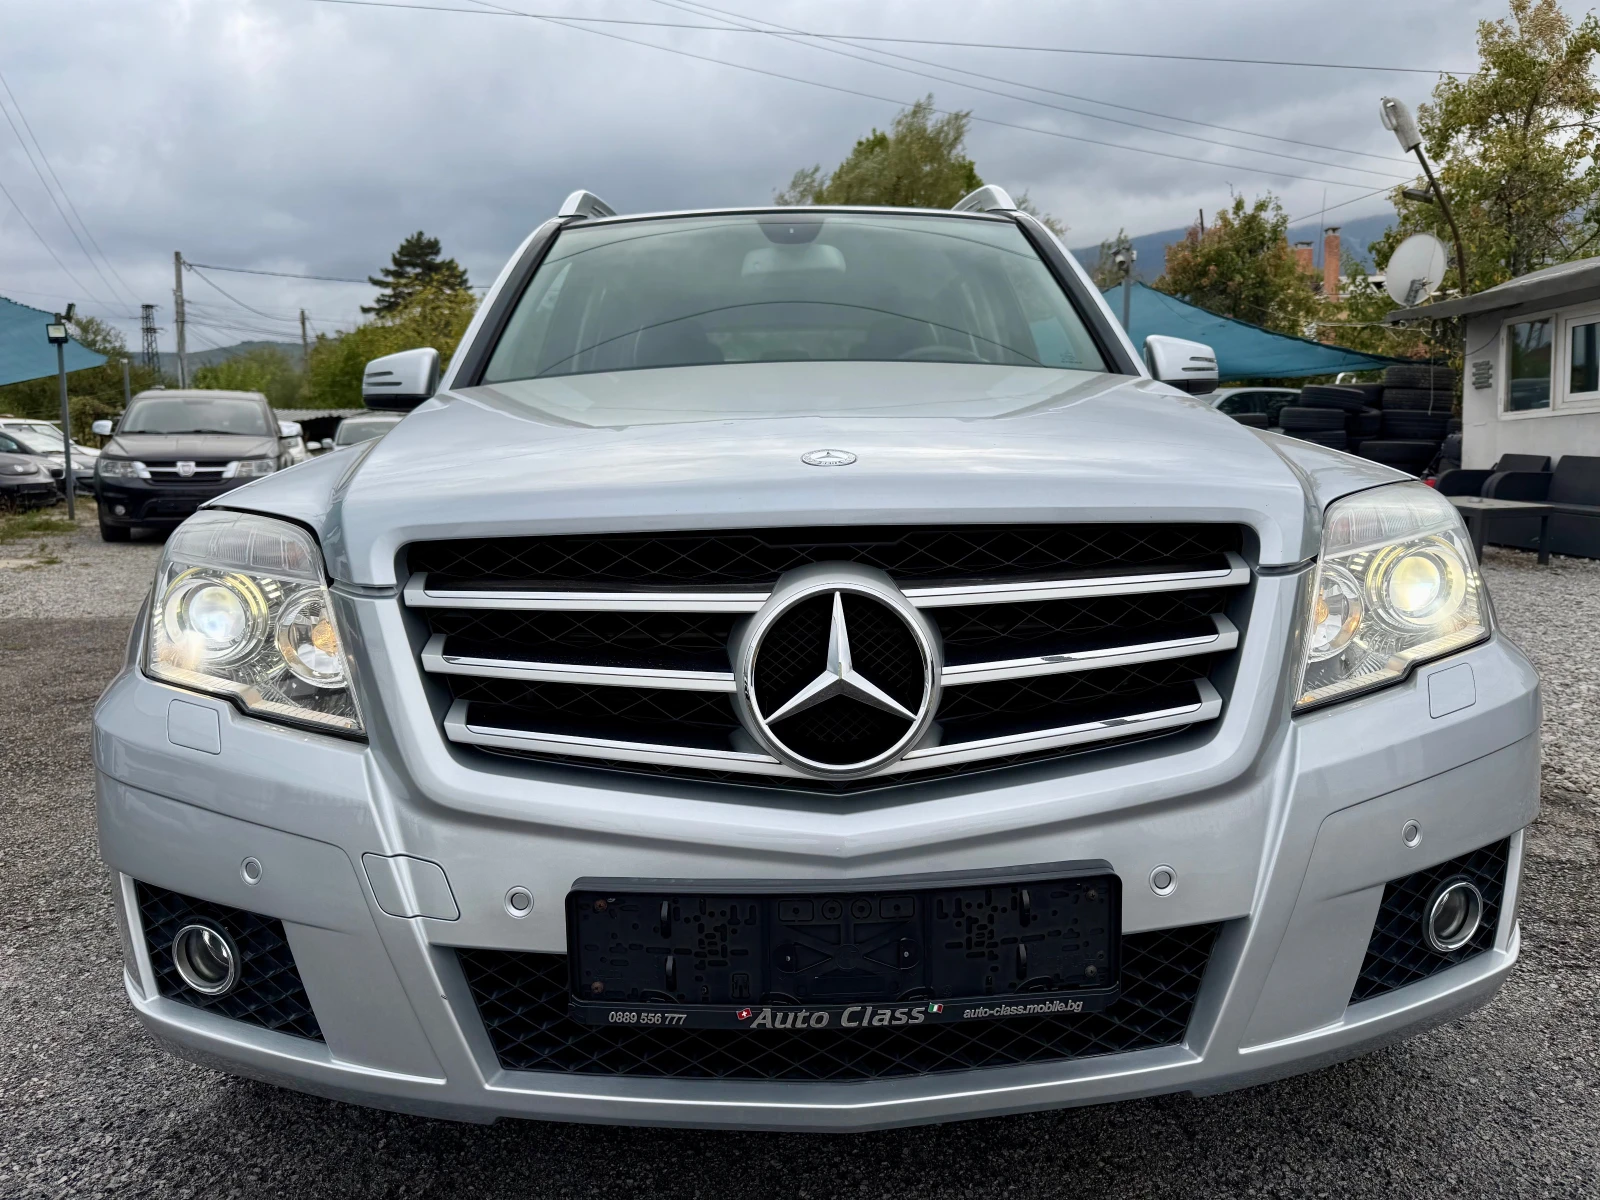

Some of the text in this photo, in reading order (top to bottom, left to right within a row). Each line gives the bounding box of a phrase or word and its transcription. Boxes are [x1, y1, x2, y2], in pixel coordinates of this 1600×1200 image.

[608, 1011, 687, 1025] 0889 556 777
[750, 1006, 925, 1029] Auto Class
[963, 1000, 1083, 1018] auto-class.mobile.bg
